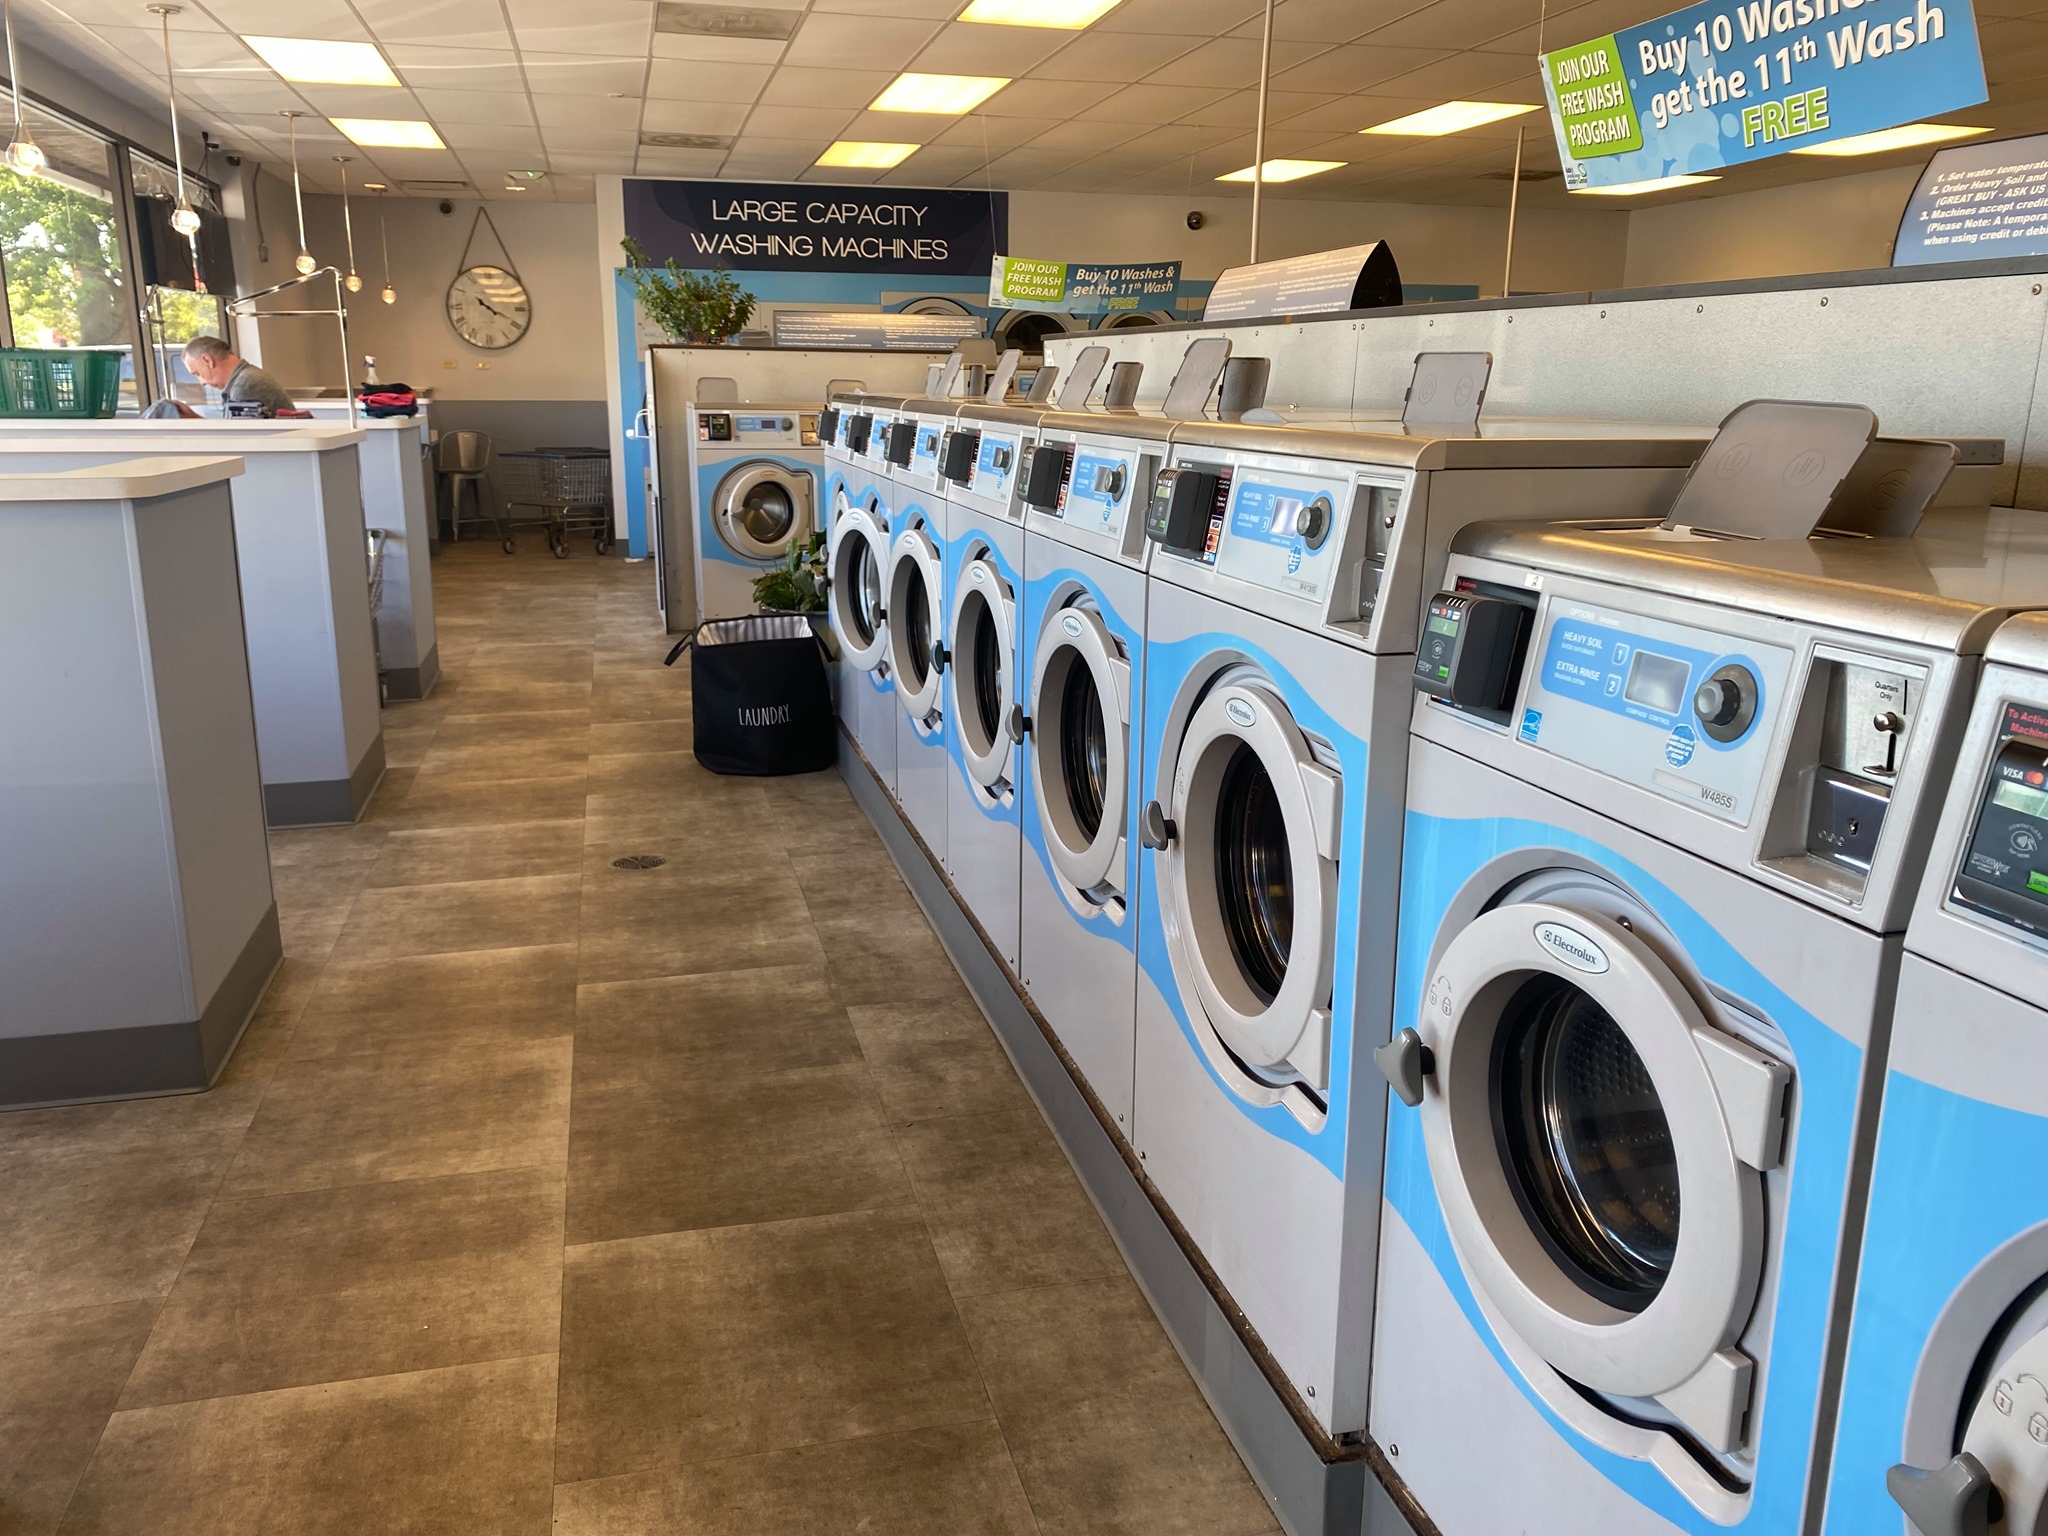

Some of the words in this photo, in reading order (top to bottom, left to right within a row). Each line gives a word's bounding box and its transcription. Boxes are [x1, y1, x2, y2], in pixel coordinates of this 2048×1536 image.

[1638, 35, 1689, 77] Buy
[1694, 14, 1733, 57] 10
[1557, 56, 1580, 84] JOIN
[1581, 49, 1610, 78] OUR
[1651, 86, 1694, 129] get
[1695, 69, 1746, 106] the
[1753, 36, 1818, 92] 11th
[1826, 3, 1945, 70] Wash
[1560, 90, 1586, 117] FREE
[1586, 80, 1625, 113] WASH
[1741, 86, 1830, 148] FREE
[1569, 115, 1631, 147] PROGRAM
[1929, 186, 1939, 196] 2.
[1941, 183, 1969, 194] Order
[1971, 179, 2003, 191] Heavy
[2004, 175, 2024, 186] Soil
[2026, 171, 2046, 183] and
[1937, 174, 1946, 183] 1.
[1947, 172, 1964, 181] Set
[1967, 167, 1994, 178] water
[1935, 194, 1972, 208] (GREAT
[1974, 190, 1998, 202] BUY
[2004, 186, 2027, 198] ASK
[2030, 184, 2046, 195] US
[712, 199, 798, 223] LARGE
[806, 202, 929, 226] CAPACITY
[1919, 211, 1929, 221] 3.
[1931, 206, 1977, 219] Machines
[1978, 202, 2014, 214] accept
[1927, 220, 1962, 234] (Please
[1964, 218, 1992, 229] Note:
[1993, 215, 2001, 225] A
[2004, 212, 2048, 225] tempora
[690, 232, 814, 257] WASHING
[822, 236, 948, 260] MACHINES
[1923, 235, 1950, 246] when
[1951, 232, 1978, 244] using
[1980, 227, 2011, 239] credit
[2013, 229, 2024, 238] or
[1011, 261, 1035, 273] JOIN
[1037, 264, 1060, 275] OUR
[1076, 268, 1101, 283] Buy
[1104, 269, 1119, 281] 10
[1121, 267, 1164, 280] Washes
[1165, 266, 1175, 278] &
[1006, 272, 1031, 285] FREE
[1033, 275, 1062, 287] WASH
[1072, 285, 1095, 298] get
[1096, 283, 1117, 295] the
[1120, 282, 1142, 295] 11th
[1143, 280, 1173, 294] Wash
[1007, 285, 1058, 298] PROGRAM
[1108, 296, 1140, 309] FREE
[1563, 630, 1588, 645] HEAVY
[1588, 636, 1604, 650] SOIL
[1617, 649, 1623, 661] 1
[1556, 660, 1578, 675] EXTRA
[1579, 667, 1601, 682] RINSE
[1609, 681, 1616, 692] 2
[1874, 681, 1899, 693] Quarters
[1880, 691, 1893, 702] Only
[2008, 708, 2019, 719] To
[2003, 766, 2024, 780] VISA
[1701, 787, 1733, 809] W485S
[1553, 934, 1597, 965] Electrolux
